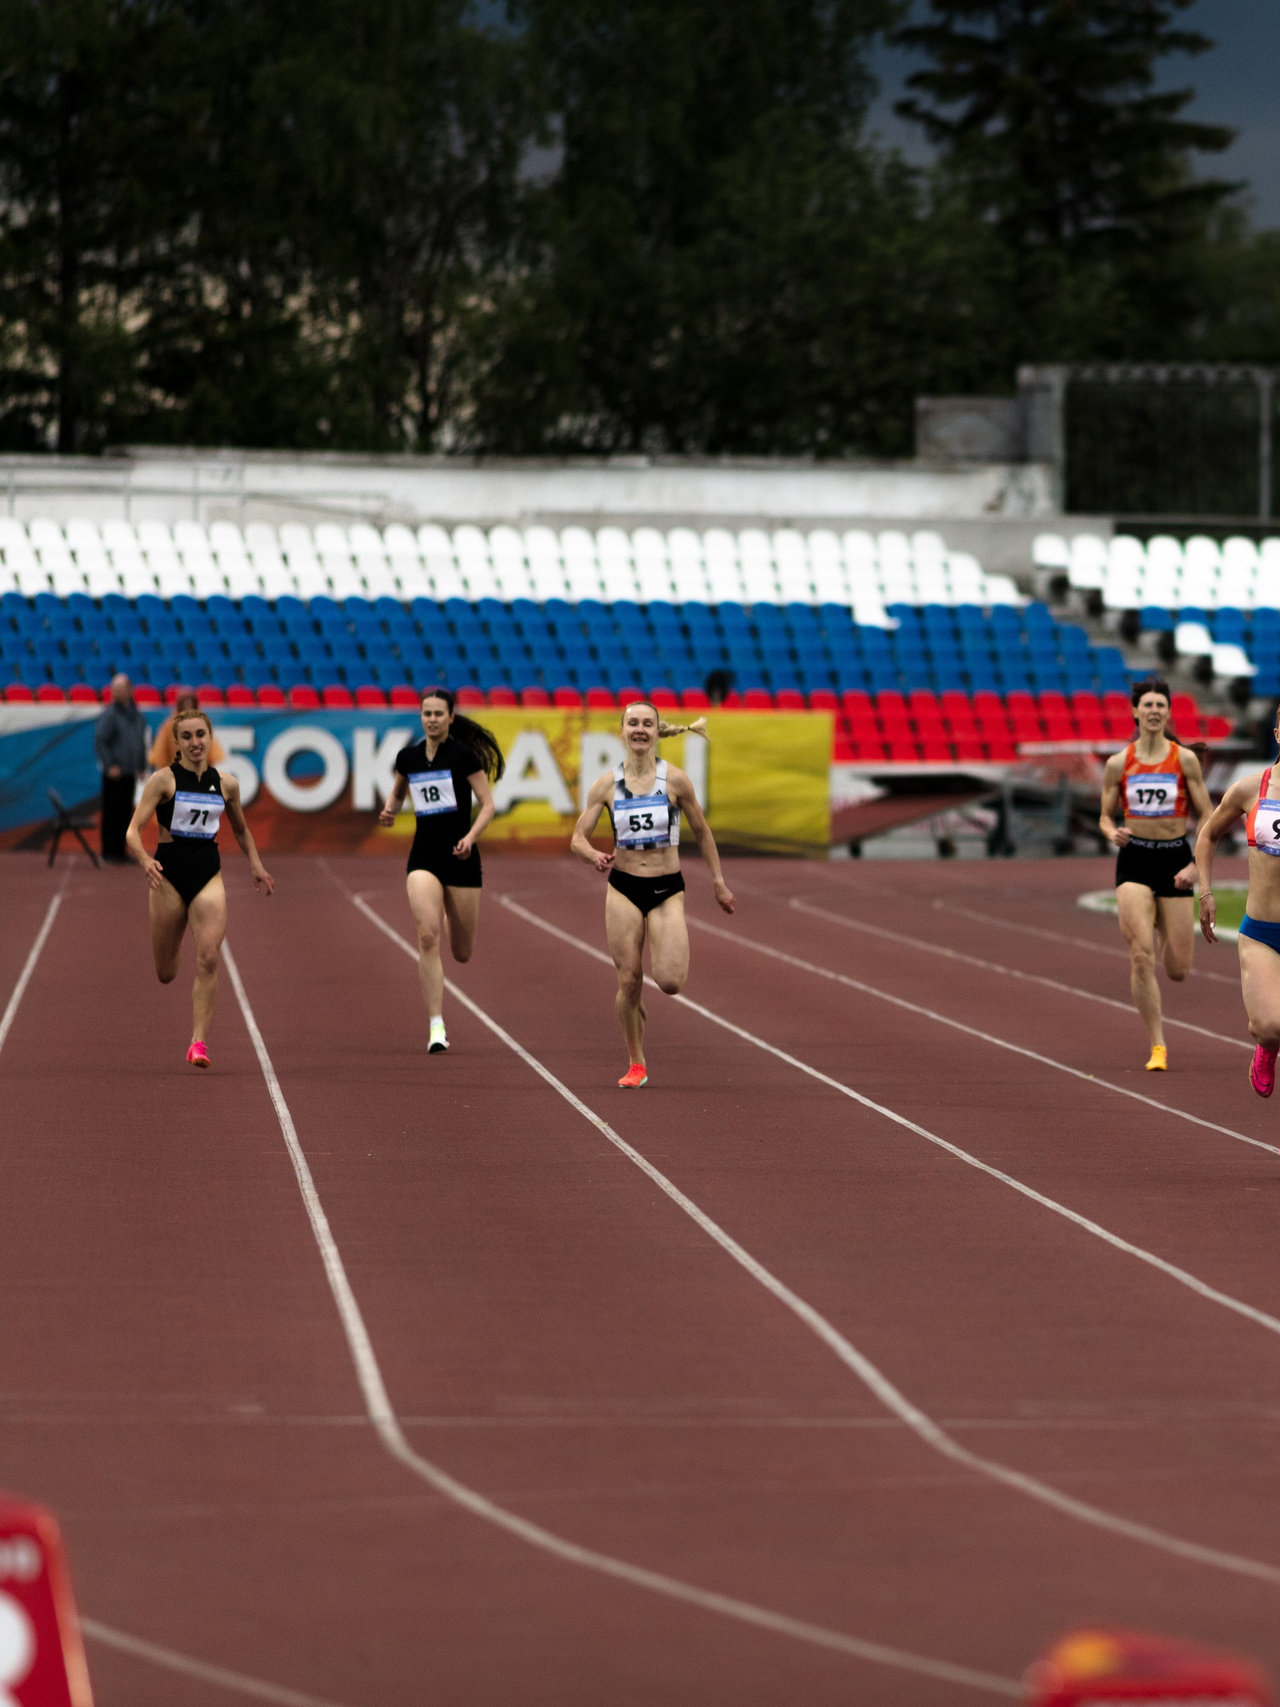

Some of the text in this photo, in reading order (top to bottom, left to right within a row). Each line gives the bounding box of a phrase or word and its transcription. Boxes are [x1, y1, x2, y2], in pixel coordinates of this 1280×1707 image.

[420, 786, 440, 803] 18
[1136, 789, 1167, 805] 179
[190, 808, 209, 826] 71
[629, 813, 654, 832] 53
[1129, 838, 1183, 849] NIKE PRO
